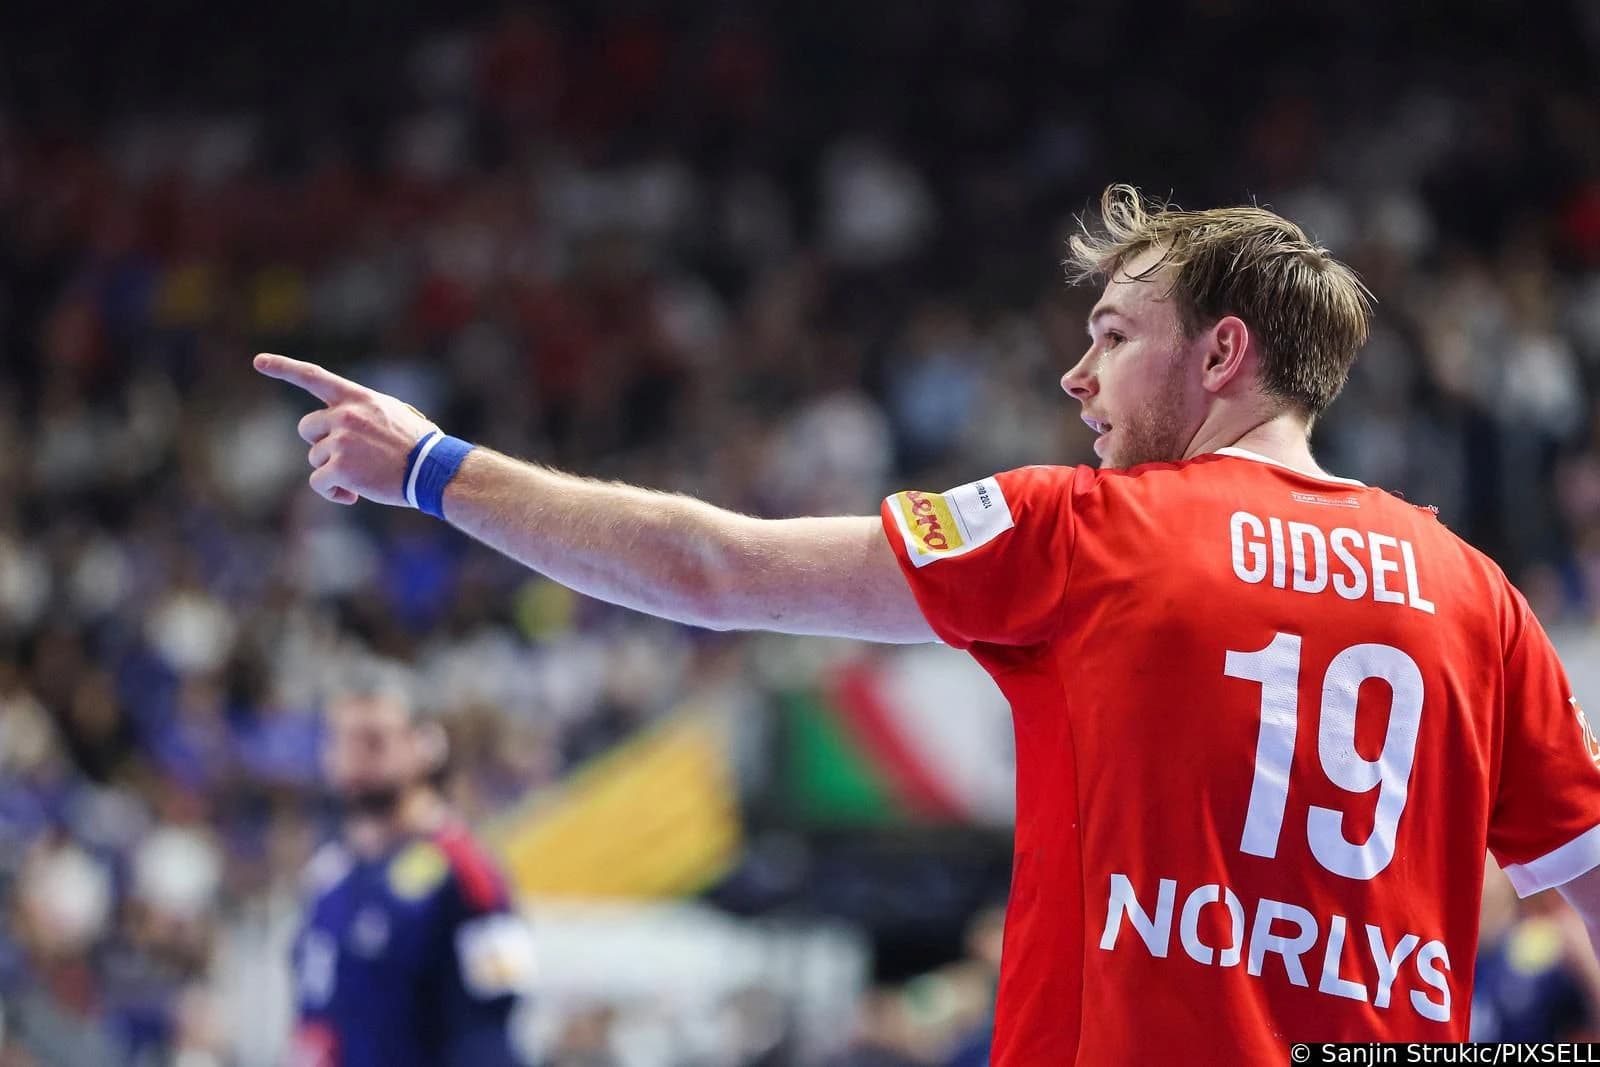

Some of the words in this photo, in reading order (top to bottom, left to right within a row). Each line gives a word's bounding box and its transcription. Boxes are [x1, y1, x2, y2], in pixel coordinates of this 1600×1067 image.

[1230, 511, 1436, 615] GIDSEL
[1223, 632, 1425, 880] 19
[1100, 873, 1452, 1022] NORLYS
